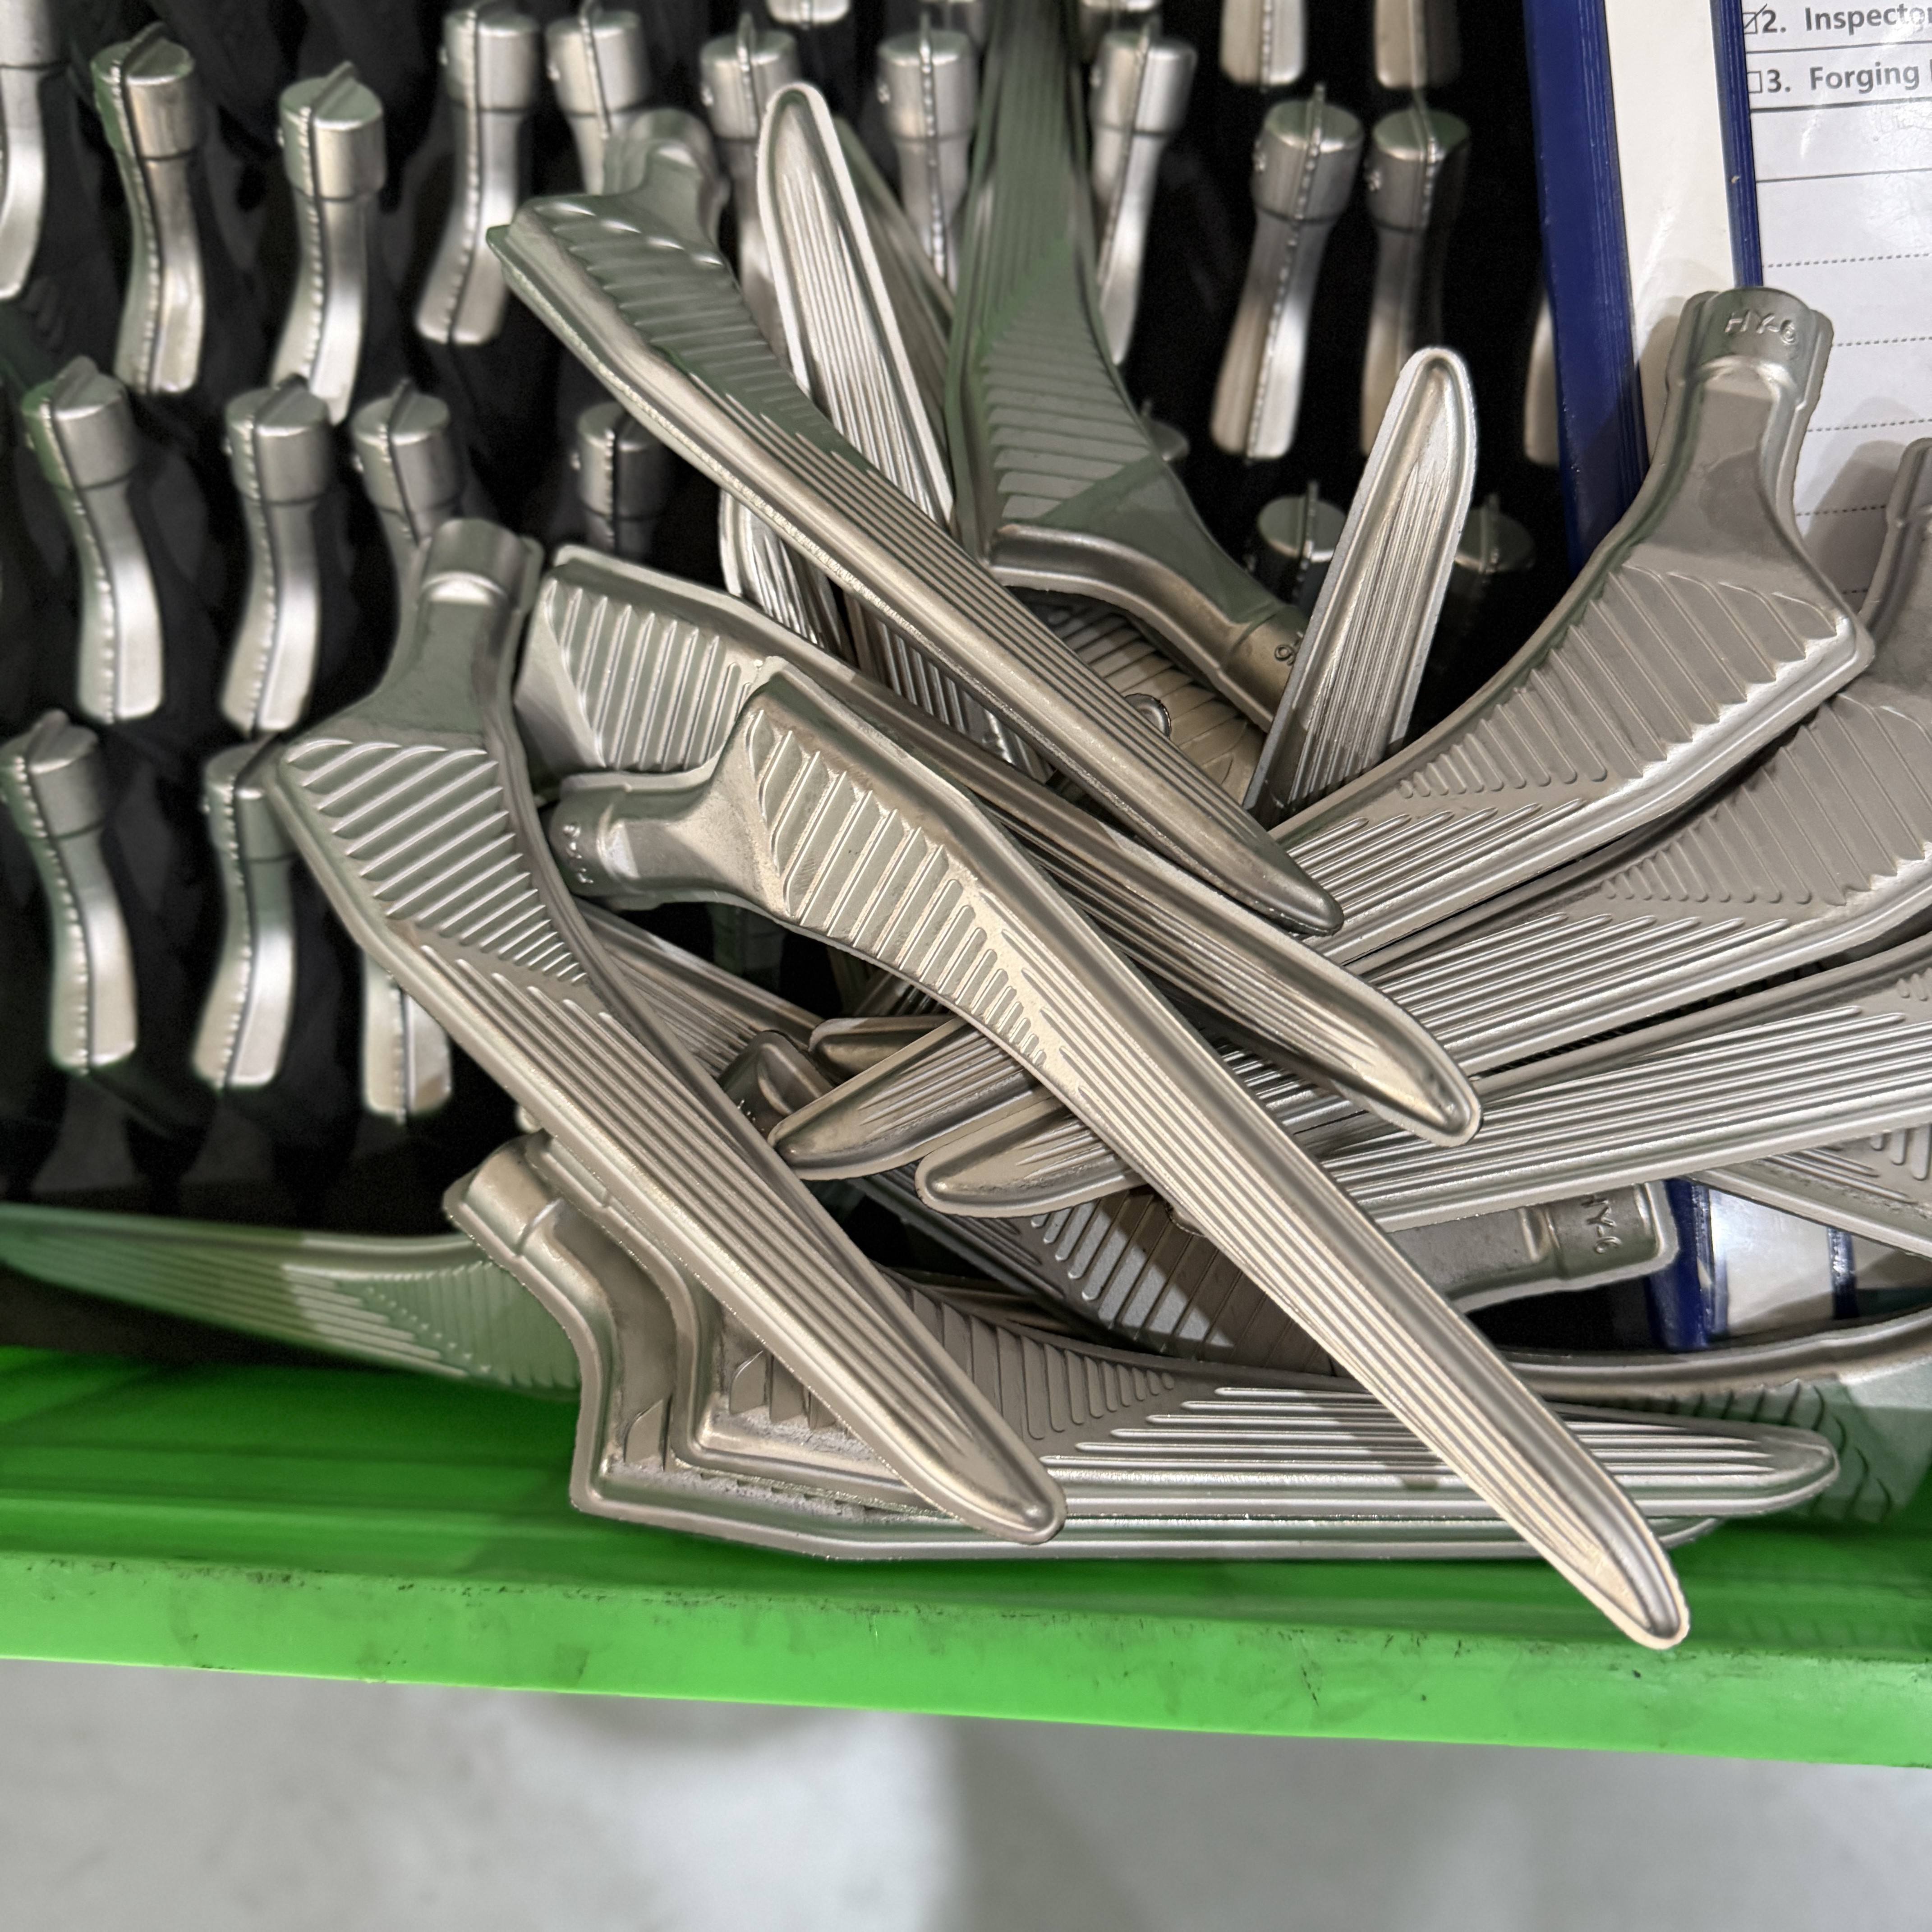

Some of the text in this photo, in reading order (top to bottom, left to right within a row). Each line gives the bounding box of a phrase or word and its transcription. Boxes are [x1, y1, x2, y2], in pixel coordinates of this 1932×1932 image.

[1762, 9, 1786, 34] 2.
[1766, 69, 1791, 93] 3.
[1809, 61, 1919, 94] Forging
